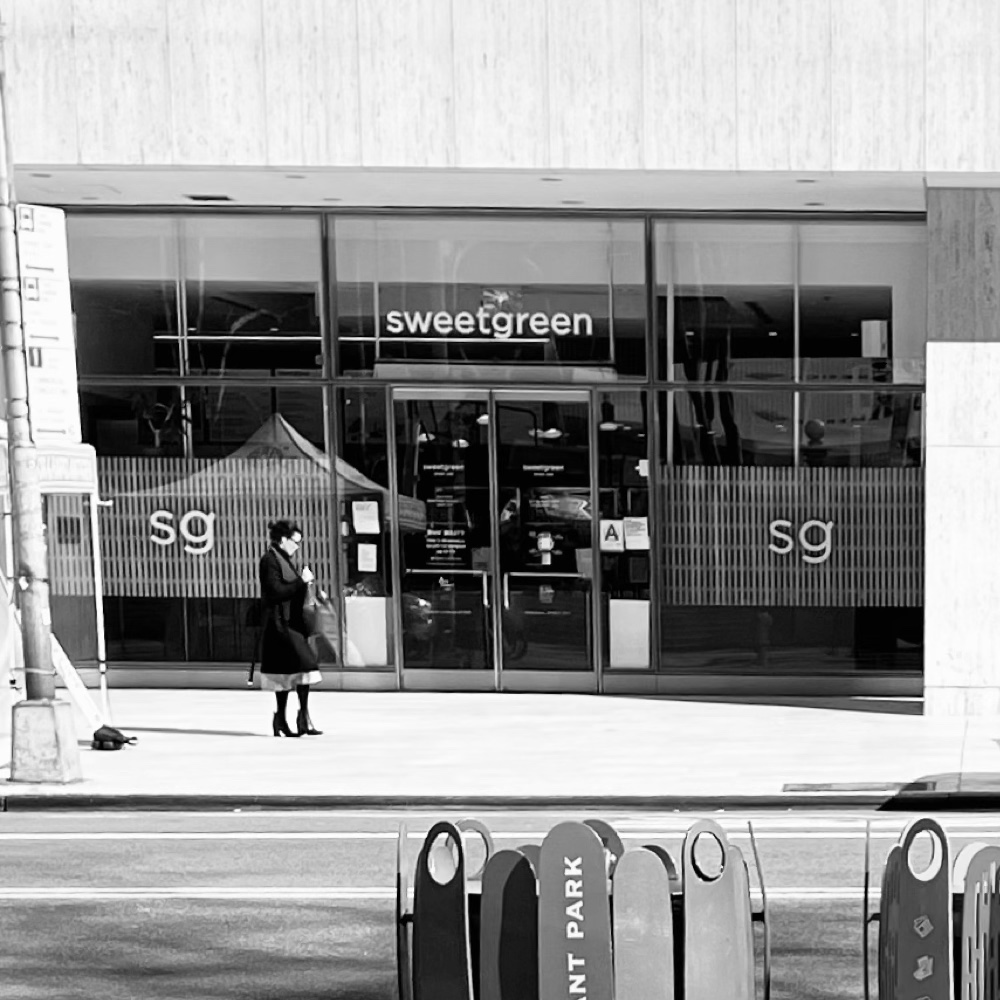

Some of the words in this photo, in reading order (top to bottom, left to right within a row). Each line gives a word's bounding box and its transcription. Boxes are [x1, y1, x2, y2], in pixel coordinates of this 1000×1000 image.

[386, 307, 593, 338] sweetgreen
[150, 510, 215, 554] sg
[604, 524, 619, 541] A
[769, 519, 833, 564] sg
[564, 856, 584, 938] PARK
